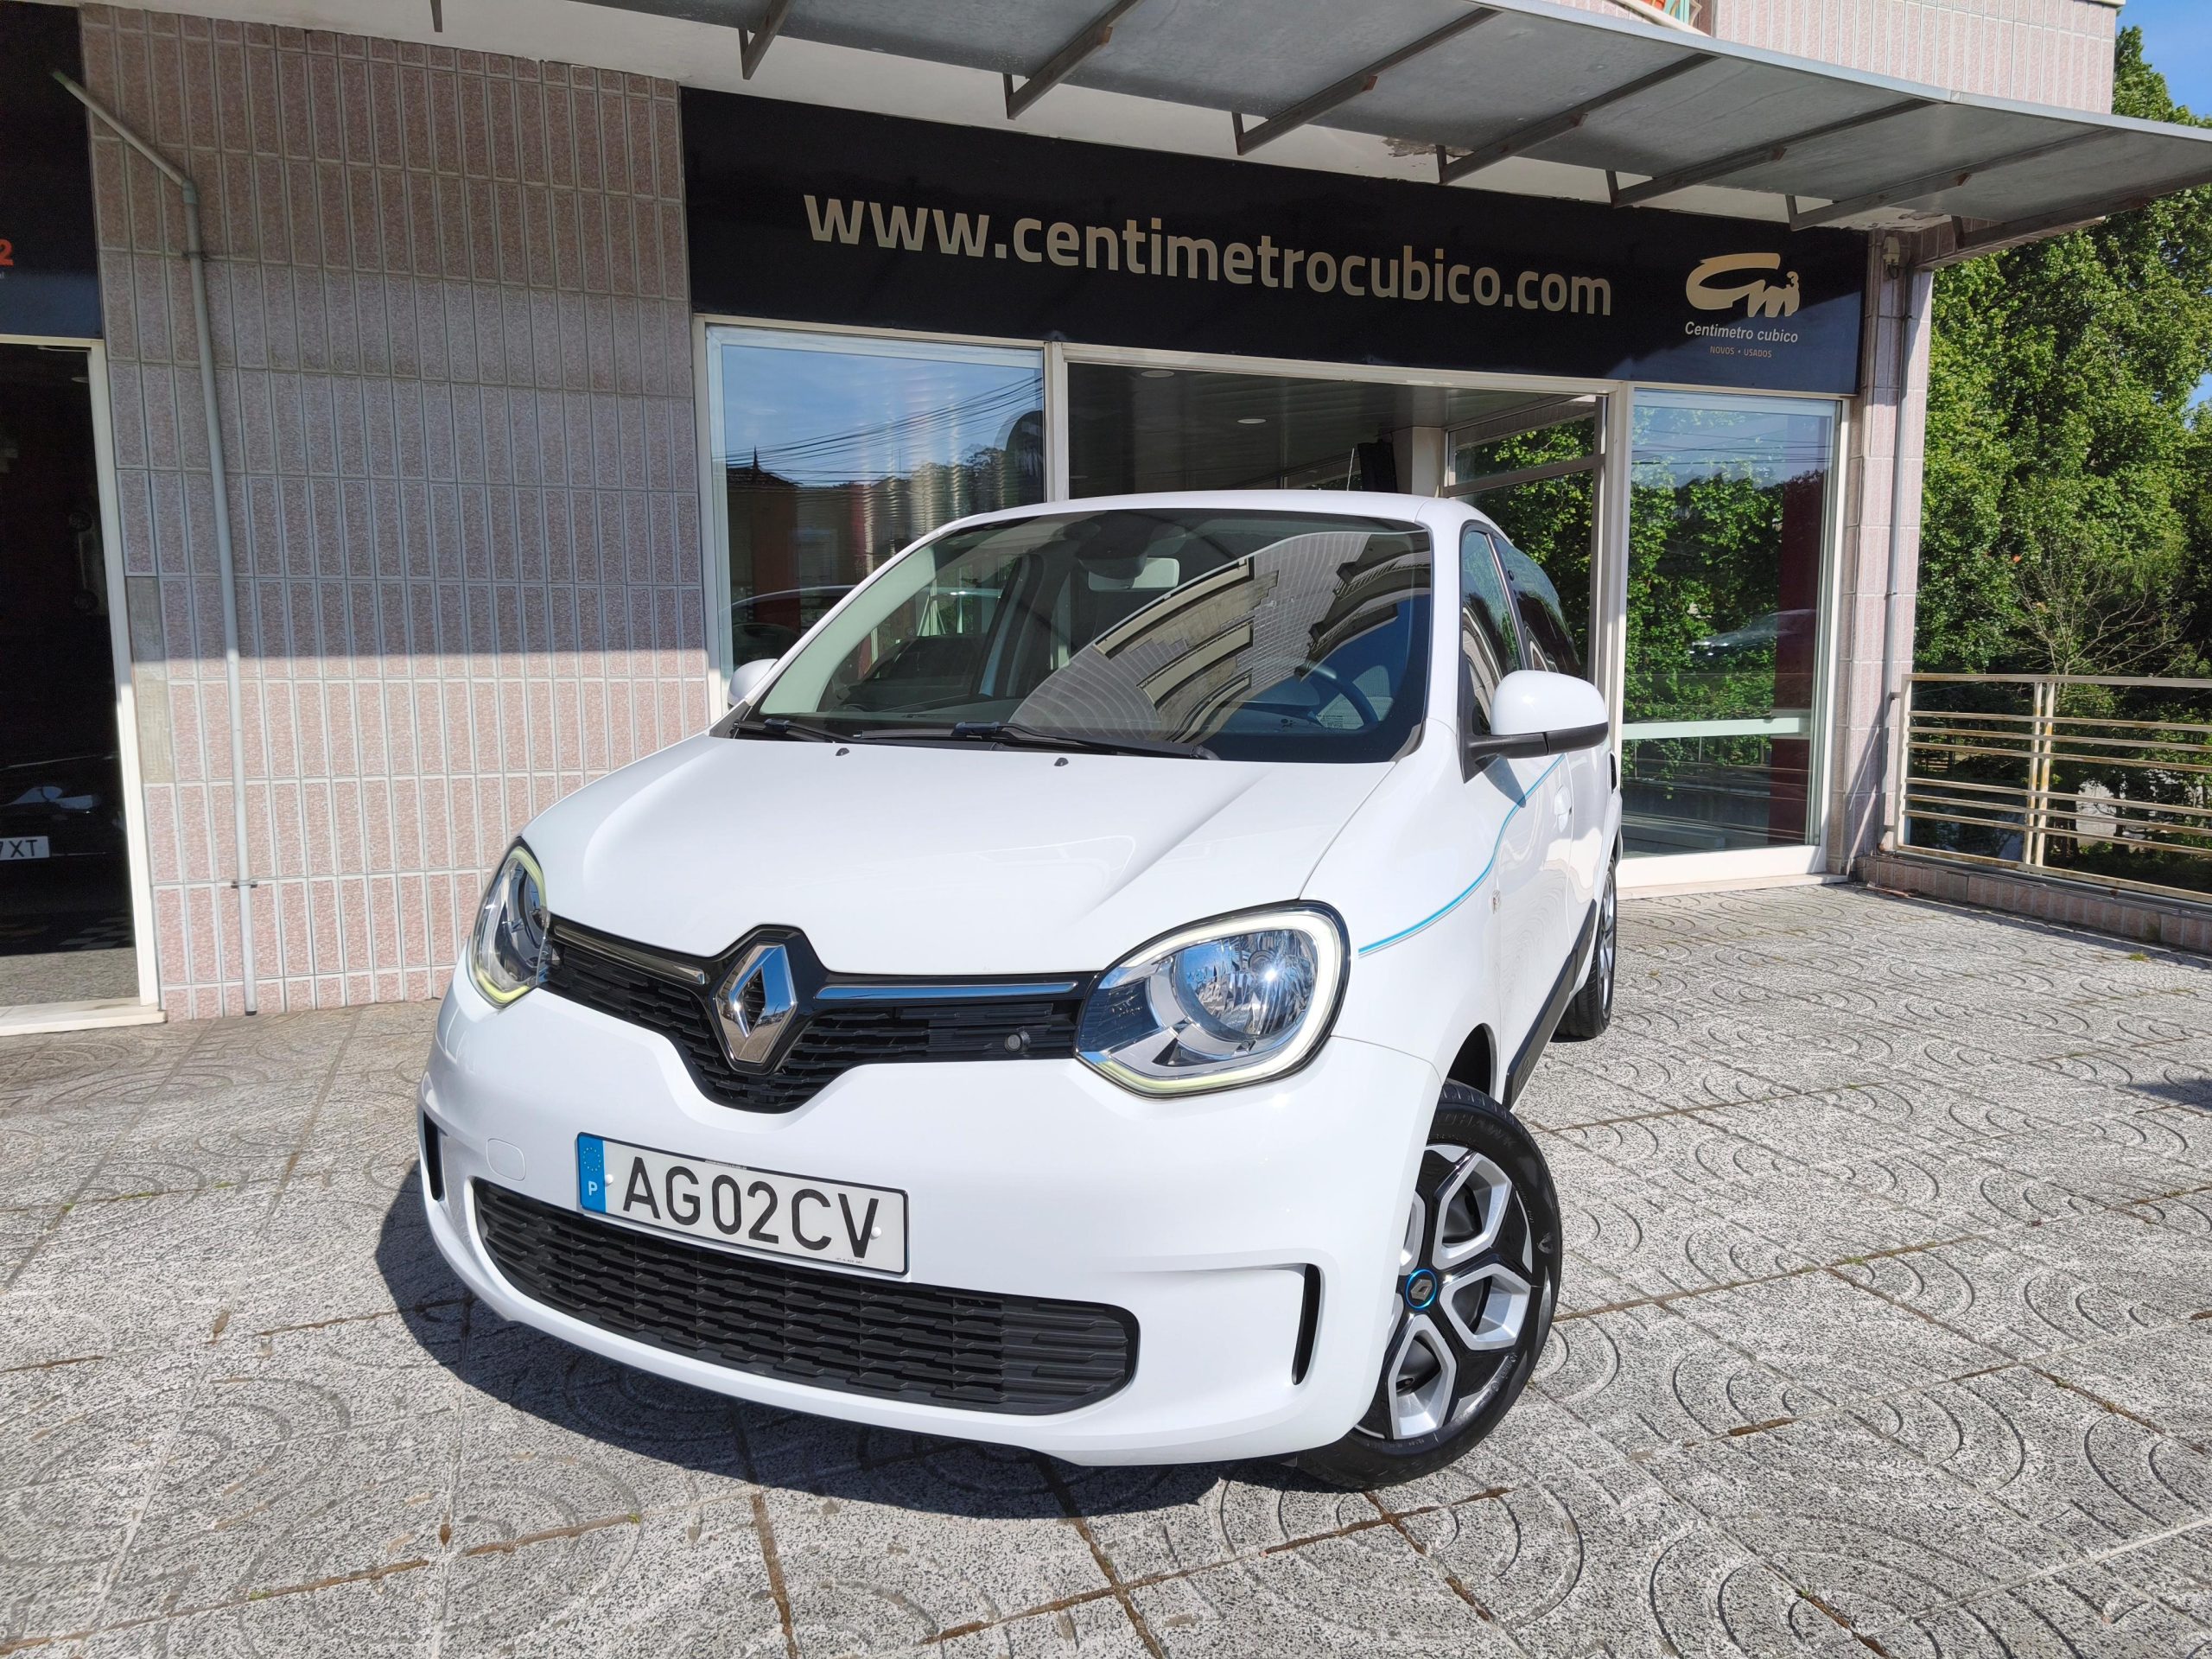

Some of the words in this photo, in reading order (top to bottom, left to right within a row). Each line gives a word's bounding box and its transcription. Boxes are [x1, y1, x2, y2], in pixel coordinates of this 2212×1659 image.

[804, 194, 1611, 316] www.centimetrocubico.com
[1685, 321, 1754, 340] Centimetro
[1757, 328, 1798, 343] cubico
[1709, 346, 1735, 355] NOVOS
[1744, 348, 1772, 359] USADOS
[588, 1180, 598, 1196] P
